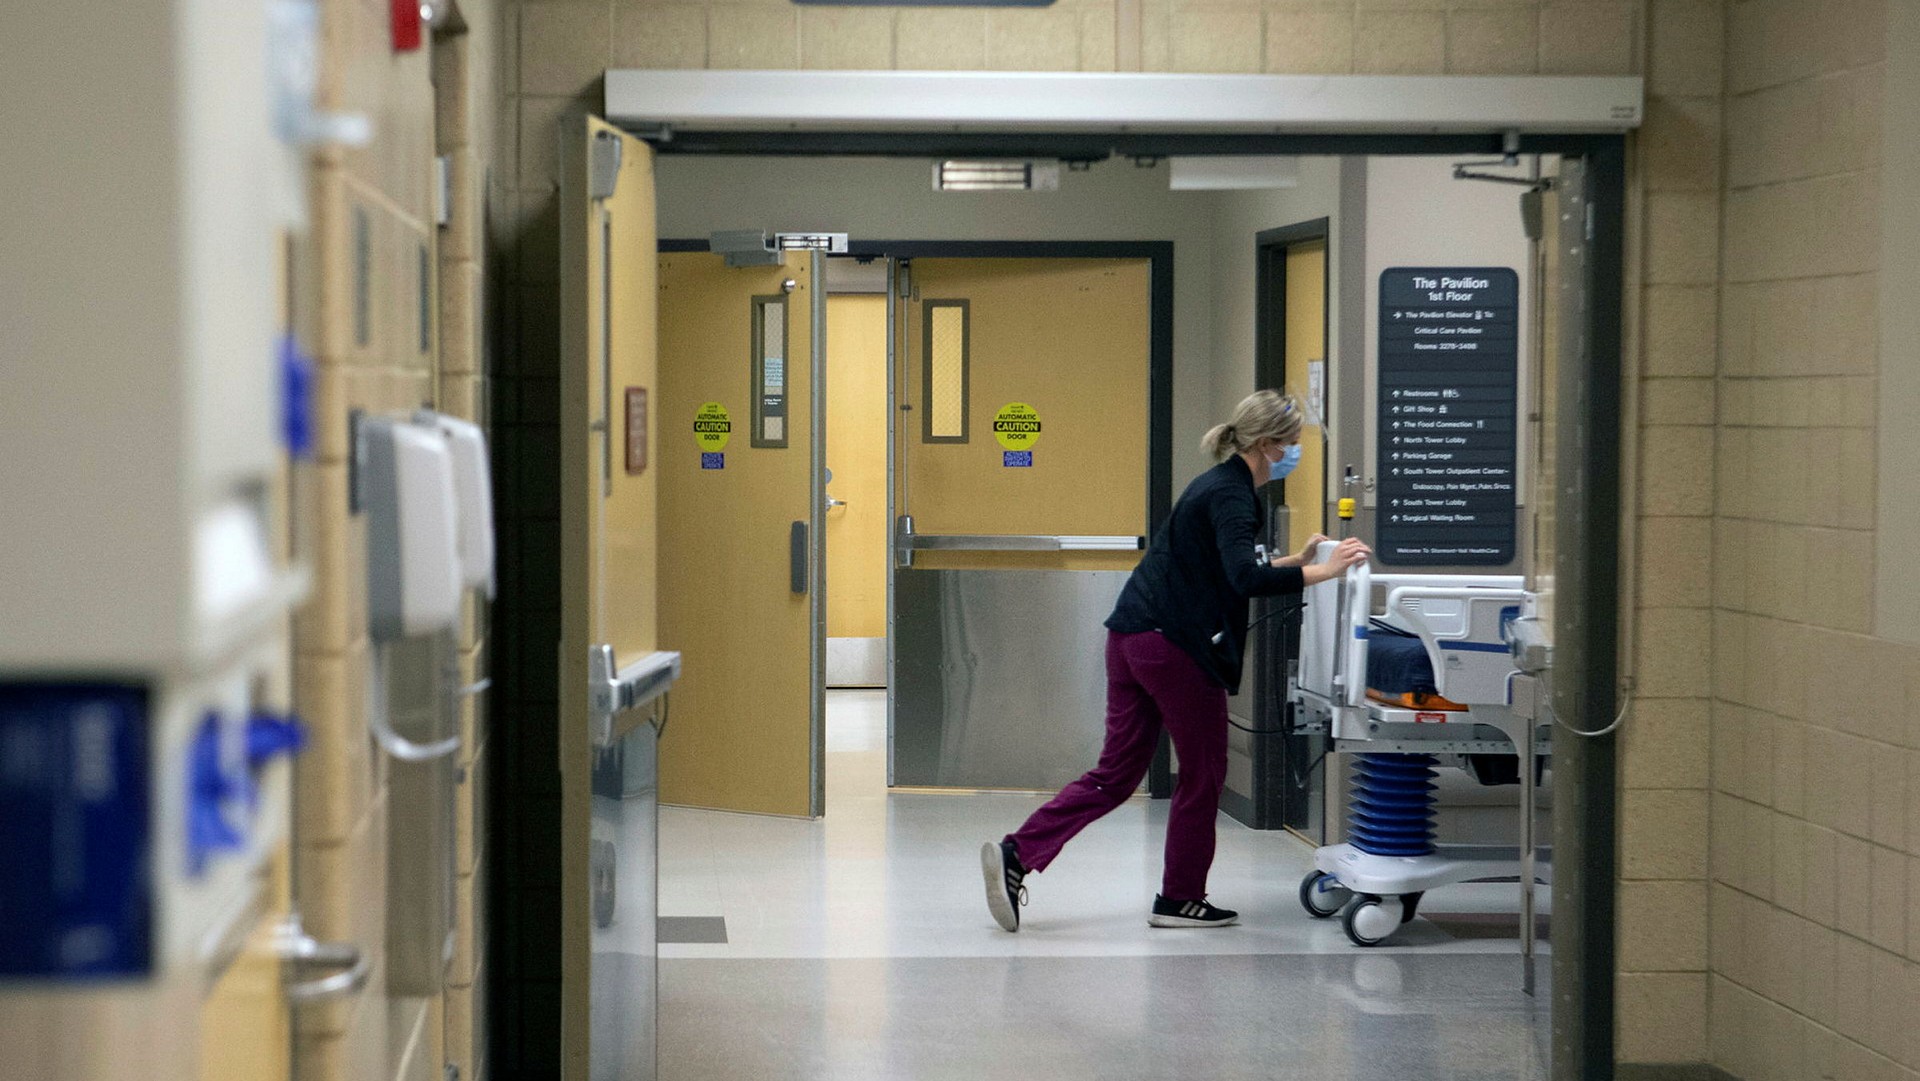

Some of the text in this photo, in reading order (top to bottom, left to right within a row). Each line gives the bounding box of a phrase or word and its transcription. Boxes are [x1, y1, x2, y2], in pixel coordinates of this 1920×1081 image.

[1413, 277, 1489, 289] The Pavilion
[1428, 292, 1473, 301] 1st Floor
[1417, 405, 1435, 413] Shop
[695, 422, 729, 431] CAUTION
[996, 422, 1038, 431] CAUTION
